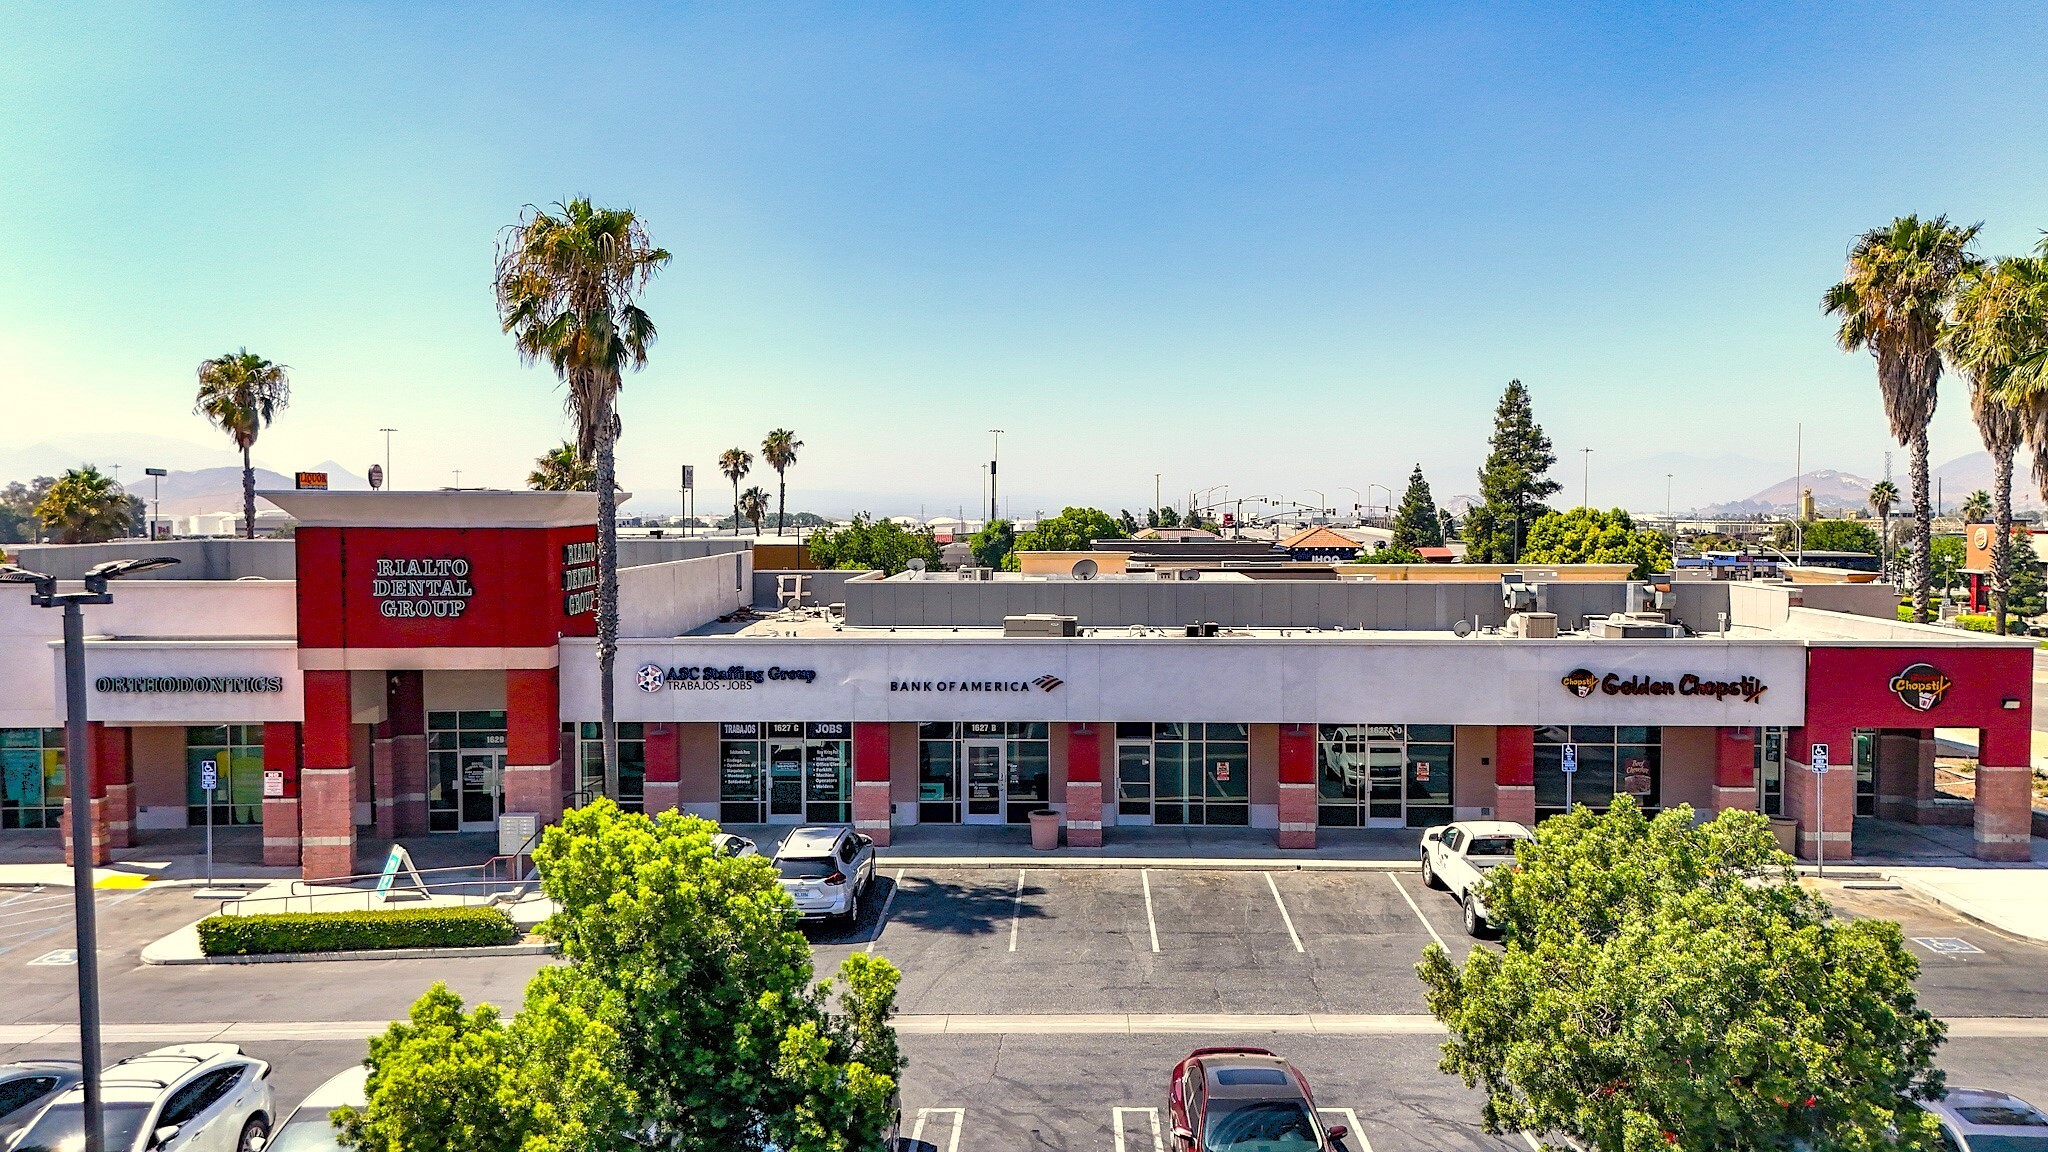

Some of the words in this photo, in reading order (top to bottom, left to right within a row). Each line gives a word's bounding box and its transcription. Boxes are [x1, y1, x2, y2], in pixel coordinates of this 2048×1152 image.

[568, 542, 596, 565] RIALTO
[376, 559, 469, 577] RIALTO
[566, 567, 598, 591] DENTAL
[373, 579, 473, 597] DENTAL
[380, 600, 466, 617] GROUP
[568, 591, 596, 616] GROUP
[665, 667, 700, 681] ASC
[702, 666, 765, 683] Staffing
[767, 666, 816, 684] Group
[96, 676, 282, 693] ORTHODONTICS
[667, 680, 720, 691] TRABAJOS
[726, 680, 752, 691] JOBS
[890, 681, 932, 692] BANK
[936, 681, 956, 692] OF
[959, 681, 1030, 692] AMERICA
[1601, 672, 1675, 696] Golden
[724, 724, 756, 734] TRABAJOS
[774, 724, 791, 732] 1627
[815, 724, 843, 734] JOBS
[971, 724, 989, 732] 1627
